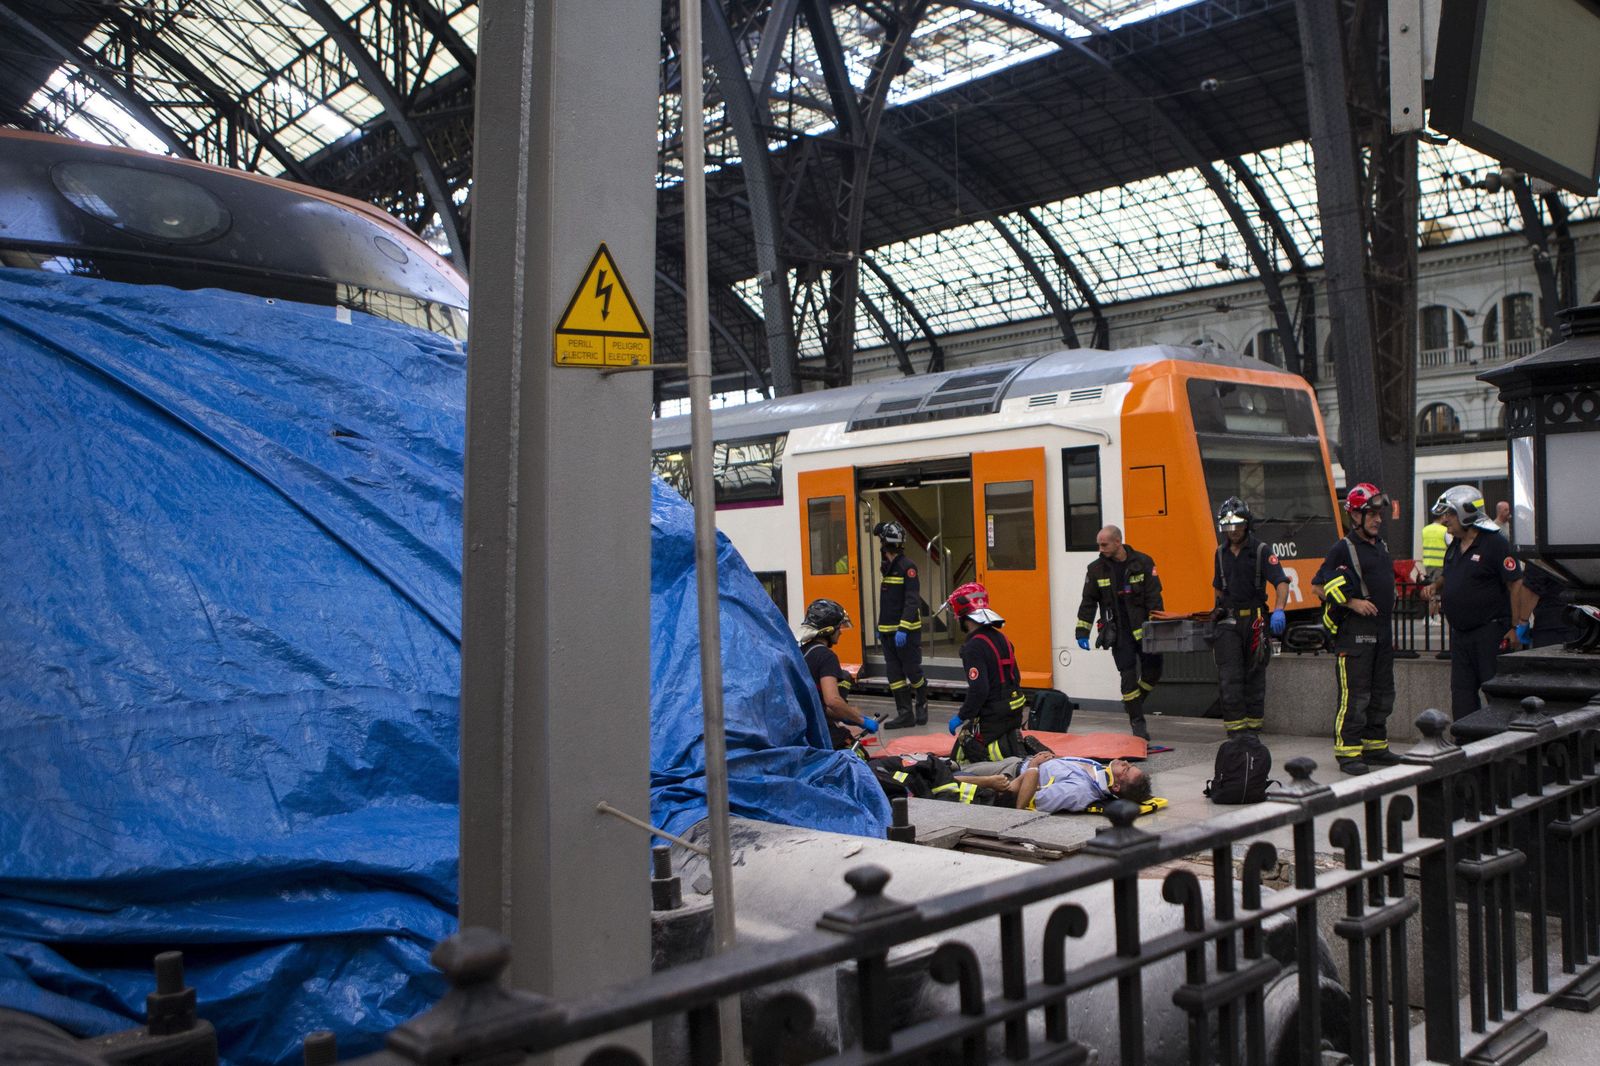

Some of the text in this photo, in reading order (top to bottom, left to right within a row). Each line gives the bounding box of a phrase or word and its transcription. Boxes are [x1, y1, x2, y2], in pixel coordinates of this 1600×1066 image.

[568, 339, 593, 348] PERILL
[612, 341, 643, 351] PELIGRO
[1272, 541, 1297, 557] 001C
